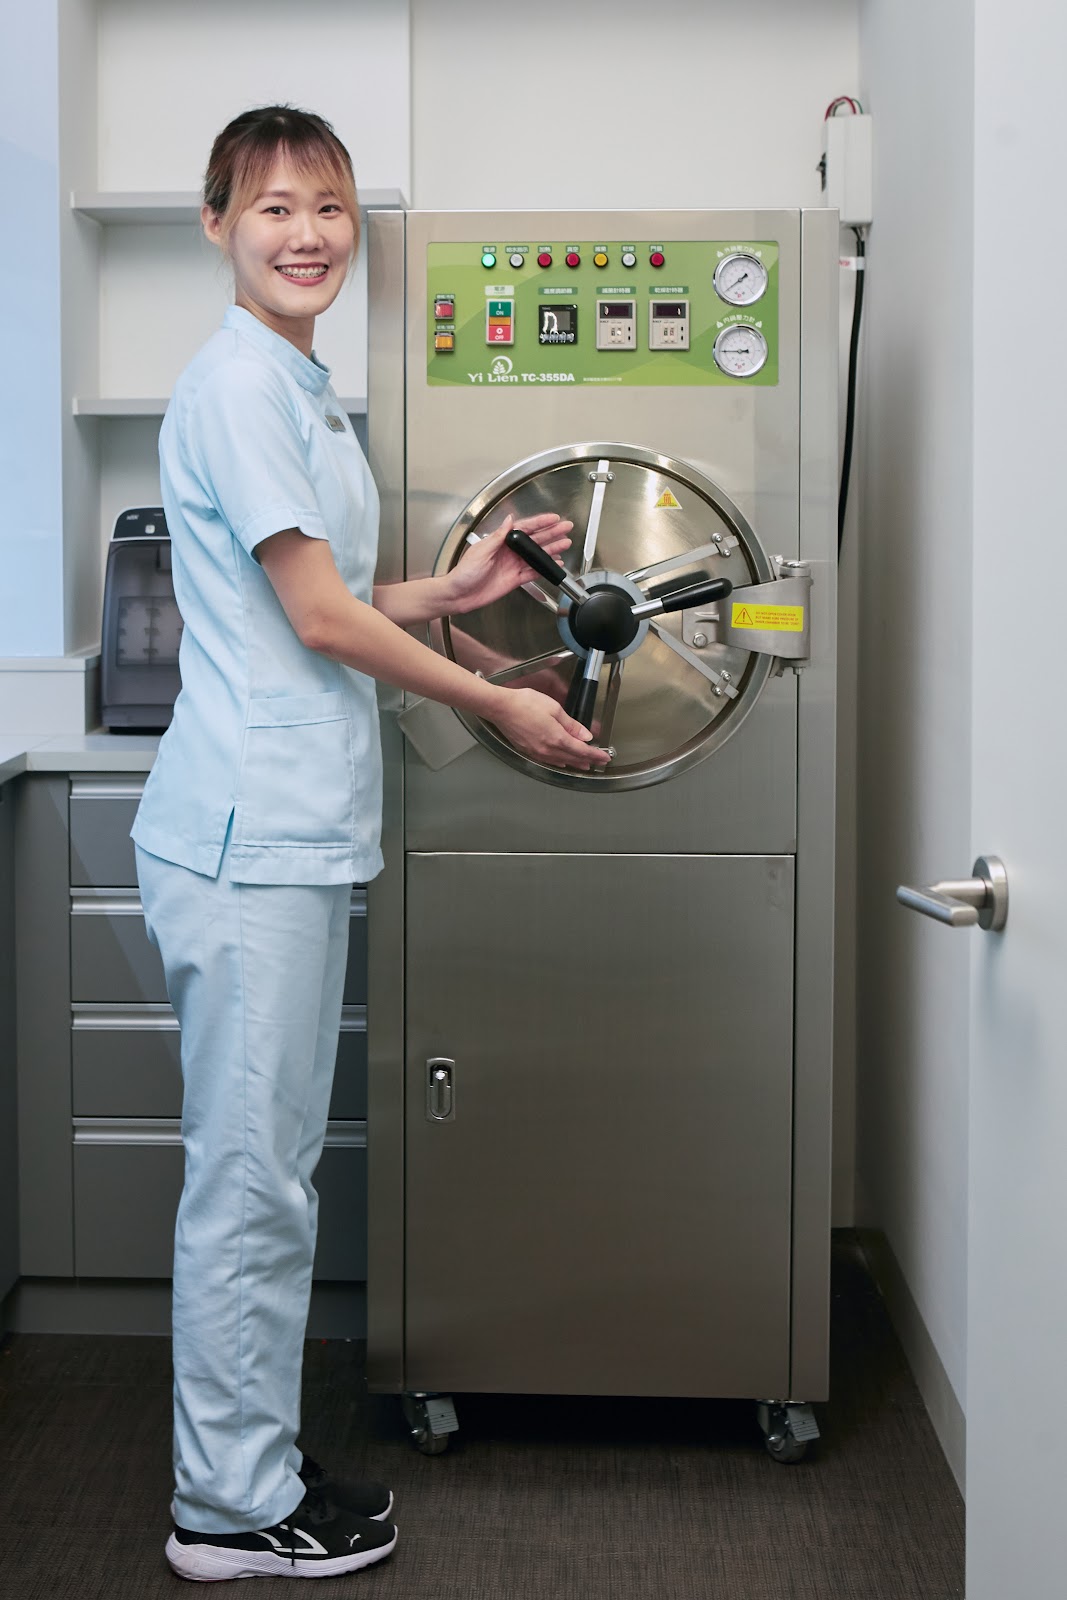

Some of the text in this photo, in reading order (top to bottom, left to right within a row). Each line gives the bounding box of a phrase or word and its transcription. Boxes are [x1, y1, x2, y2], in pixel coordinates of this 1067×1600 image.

[467, 372, 483, 383] Yi
[487, 372, 519, 383] Lien
[521, 373, 575, 382] TC-355DA
